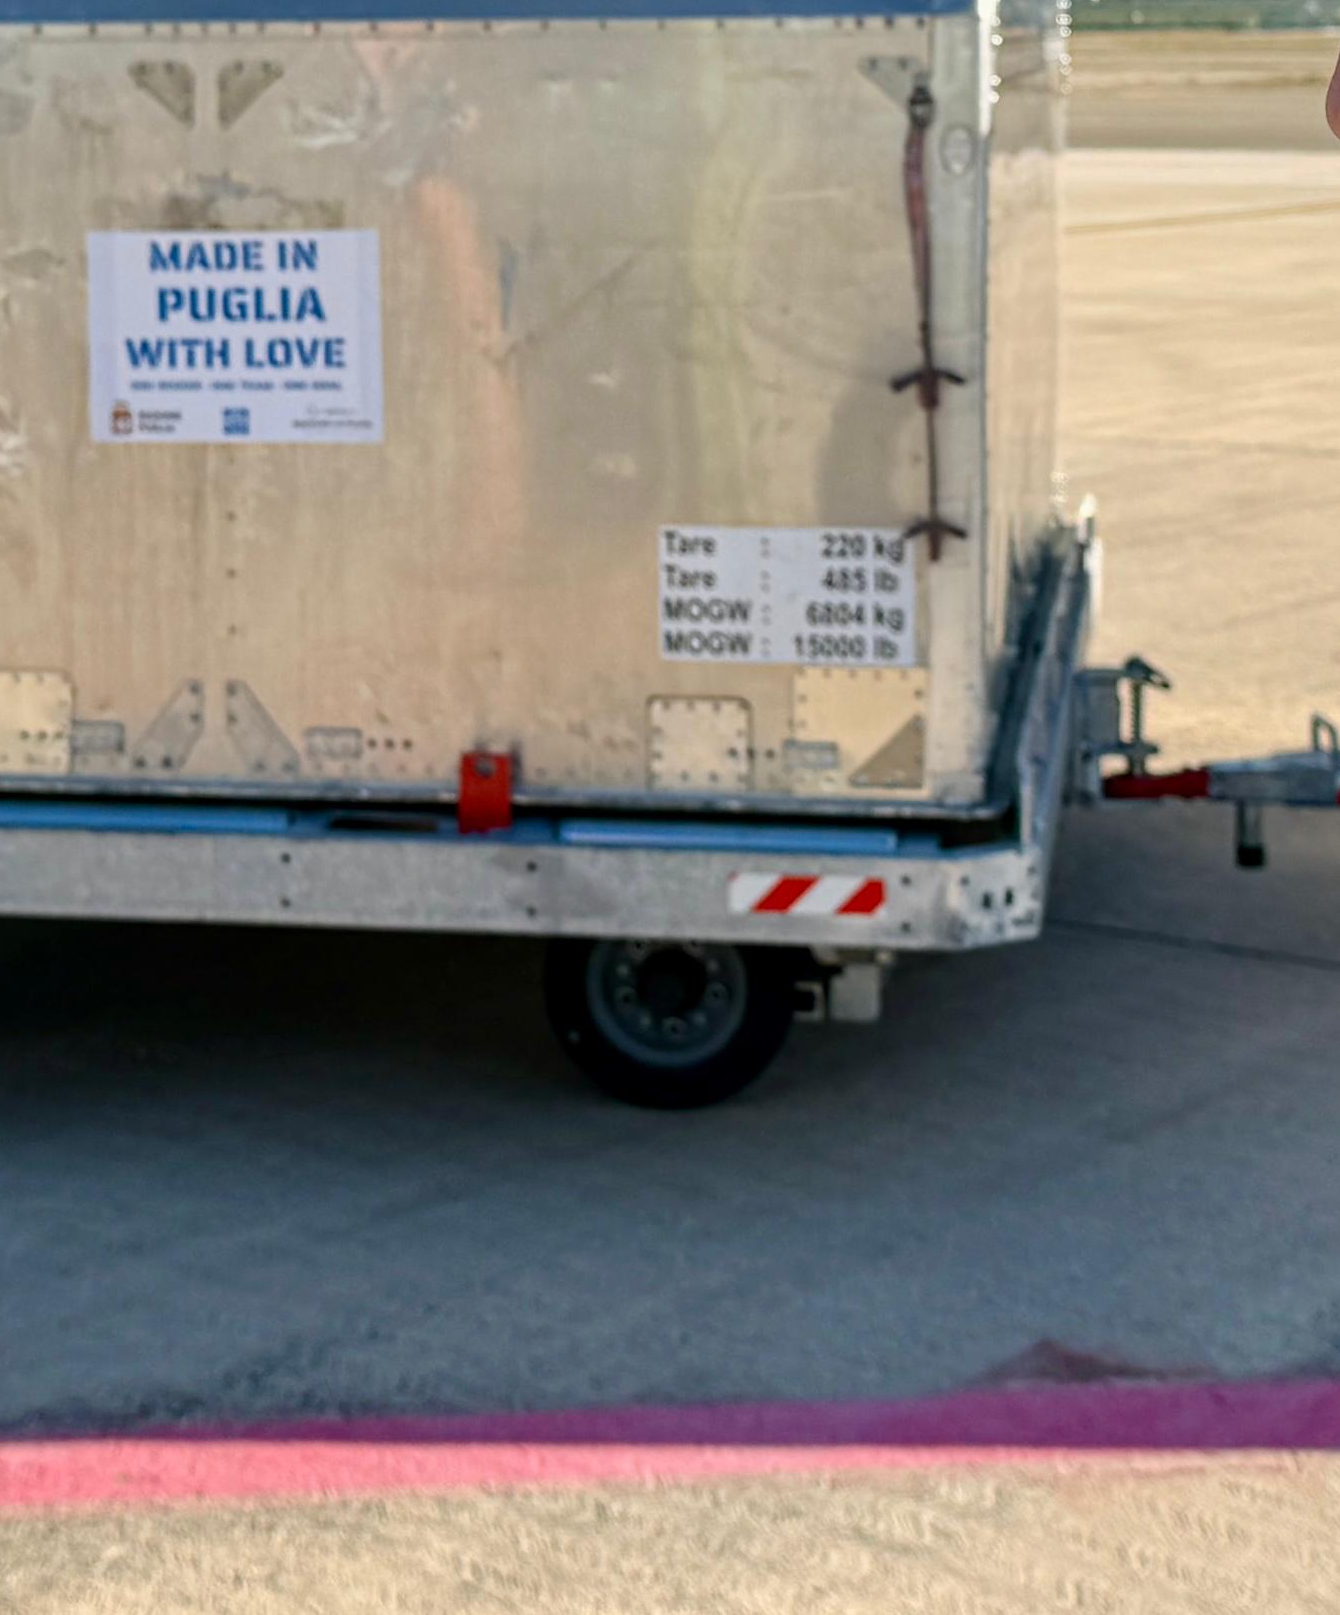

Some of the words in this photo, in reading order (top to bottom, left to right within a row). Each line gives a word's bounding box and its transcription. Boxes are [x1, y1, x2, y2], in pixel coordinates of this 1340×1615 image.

[150, 241, 263, 271] MADE
[278, 241, 317, 270] IN
[158, 287, 325, 322] PUGLIA
[126, 339, 230, 368] WITH
[245, 338, 345, 368] LOVE
[664, 531, 715, 555] Tare
[822, 534, 866, 559] 220
[873, 534, 904, 565] kg
[664, 564, 715, 589] Tare
[873, 567, 900, 593] lb
[663, 598, 751, 622] MOGW
[873, 601, 904, 632] kg
[664, 631, 751, 655] MOGW
[873, 635, 899, 660] lb
